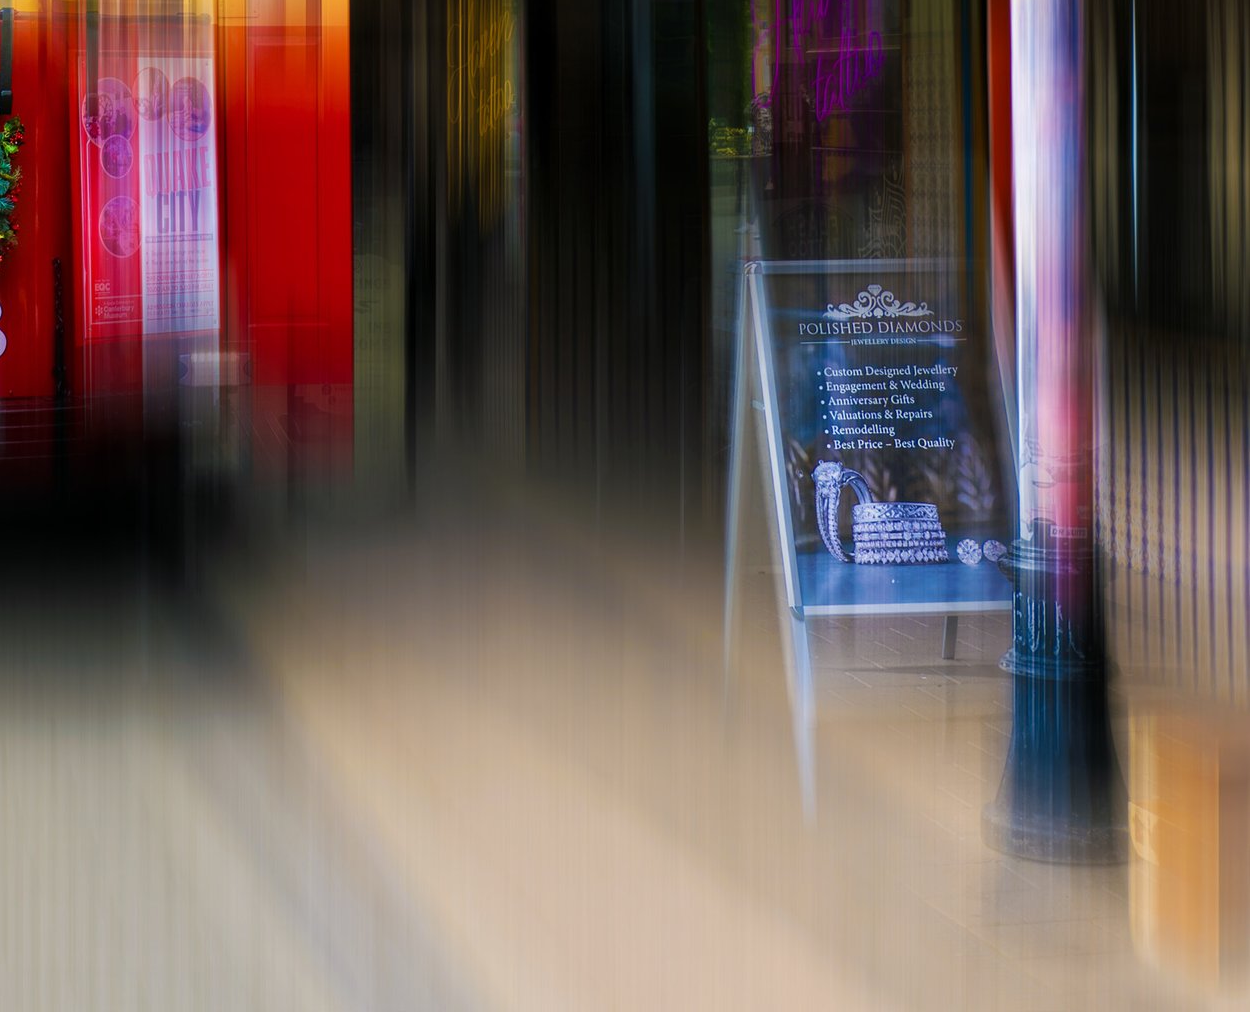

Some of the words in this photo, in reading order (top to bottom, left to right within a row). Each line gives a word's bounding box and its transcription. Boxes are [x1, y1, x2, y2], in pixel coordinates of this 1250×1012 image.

[144, 146, 211, 197] QUAKE
[157, 190, 200, 233] CITY
[799, 321, 873, 335] POLISHED
[877, 320, 963, 334] DIAMONDS
[850, 338, 889, 346] JEWELLERY
[824, 367, 863, 377] Custom
[865, 366, 911, 378] Designed
[913, 364, 958, 377] Jewellery
[826, 381, 887, 394] Engagement
[889, 380, 898, 390] &
[900, 379, 946, 392] Wedding
[828, 396, 888, 408] Anniversary
[891, 394, 915, 405] Gifts
[829, 410, 882, 421] Valuations
[884, 409, 893, 420] &
[895, 409, 933, 421] Repairs
[832, 424, 896, 436] Remodelling
[834, 440, 855, 450] Best
[858, 439, 883, 449] Price
[894, 438, 916, 448] Best
[917, 437, 956, 450] Quality
